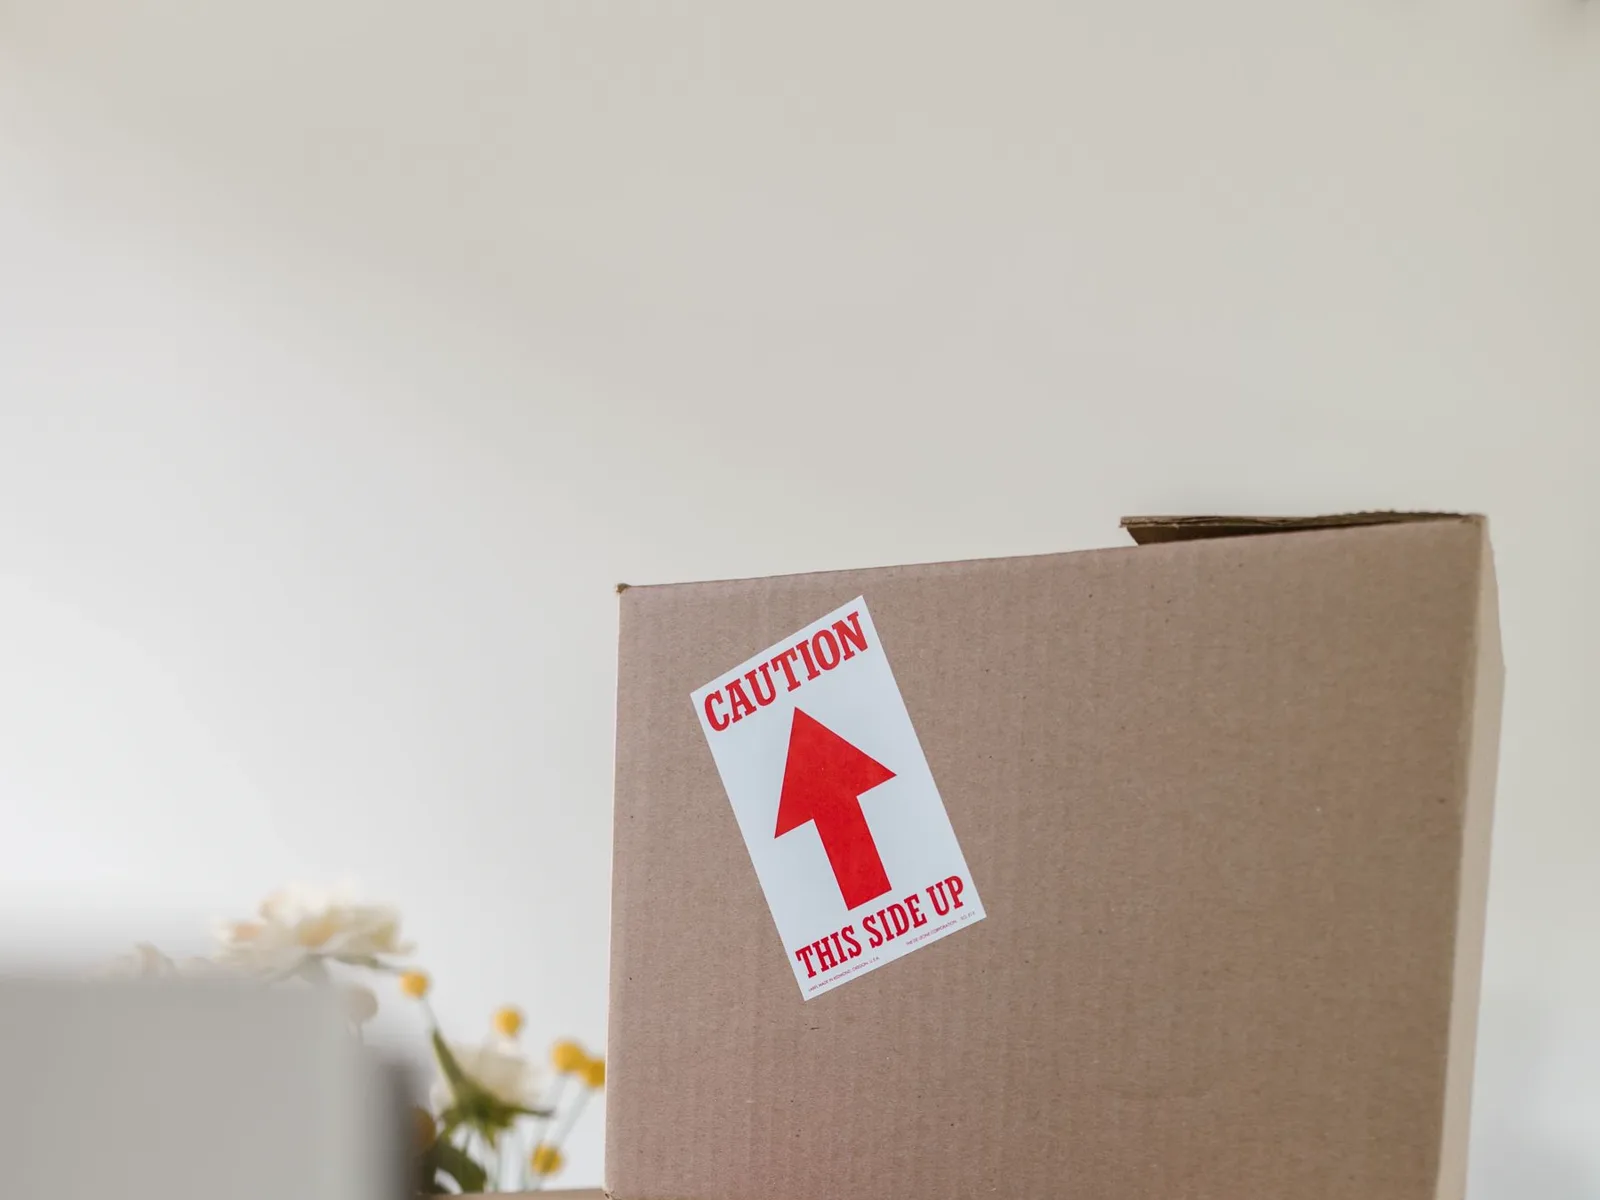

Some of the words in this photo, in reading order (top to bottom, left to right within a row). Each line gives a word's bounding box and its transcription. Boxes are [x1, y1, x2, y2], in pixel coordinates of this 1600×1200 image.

[704, 611, 869, 732] CAUTION
[795, 924, 863, 979] THIS
[862, 893, 928, 949] SIDE
[926, 875, 964, 917] UP
